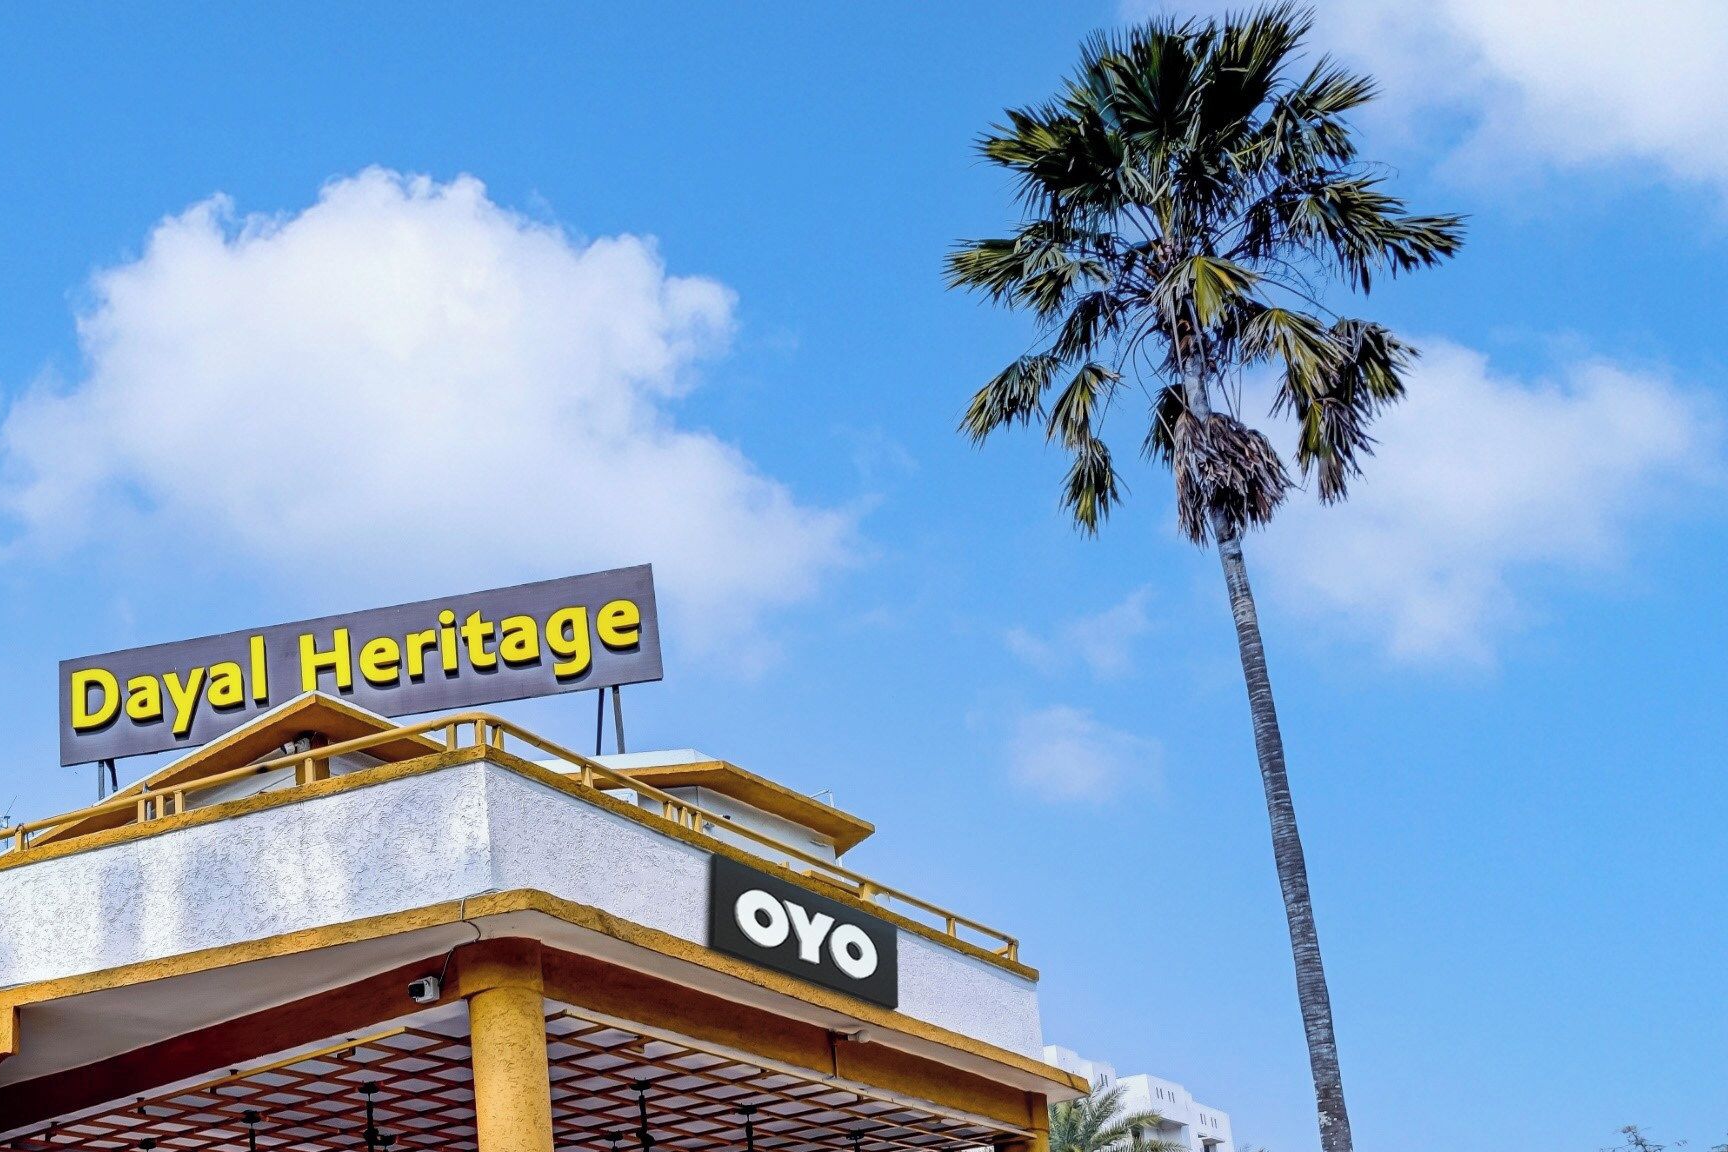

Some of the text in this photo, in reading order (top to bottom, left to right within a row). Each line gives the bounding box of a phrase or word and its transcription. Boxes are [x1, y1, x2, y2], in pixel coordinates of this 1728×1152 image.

[71, 599, 641, 734] Dayal Heritage
[735, 889, 878, 980] OYO
